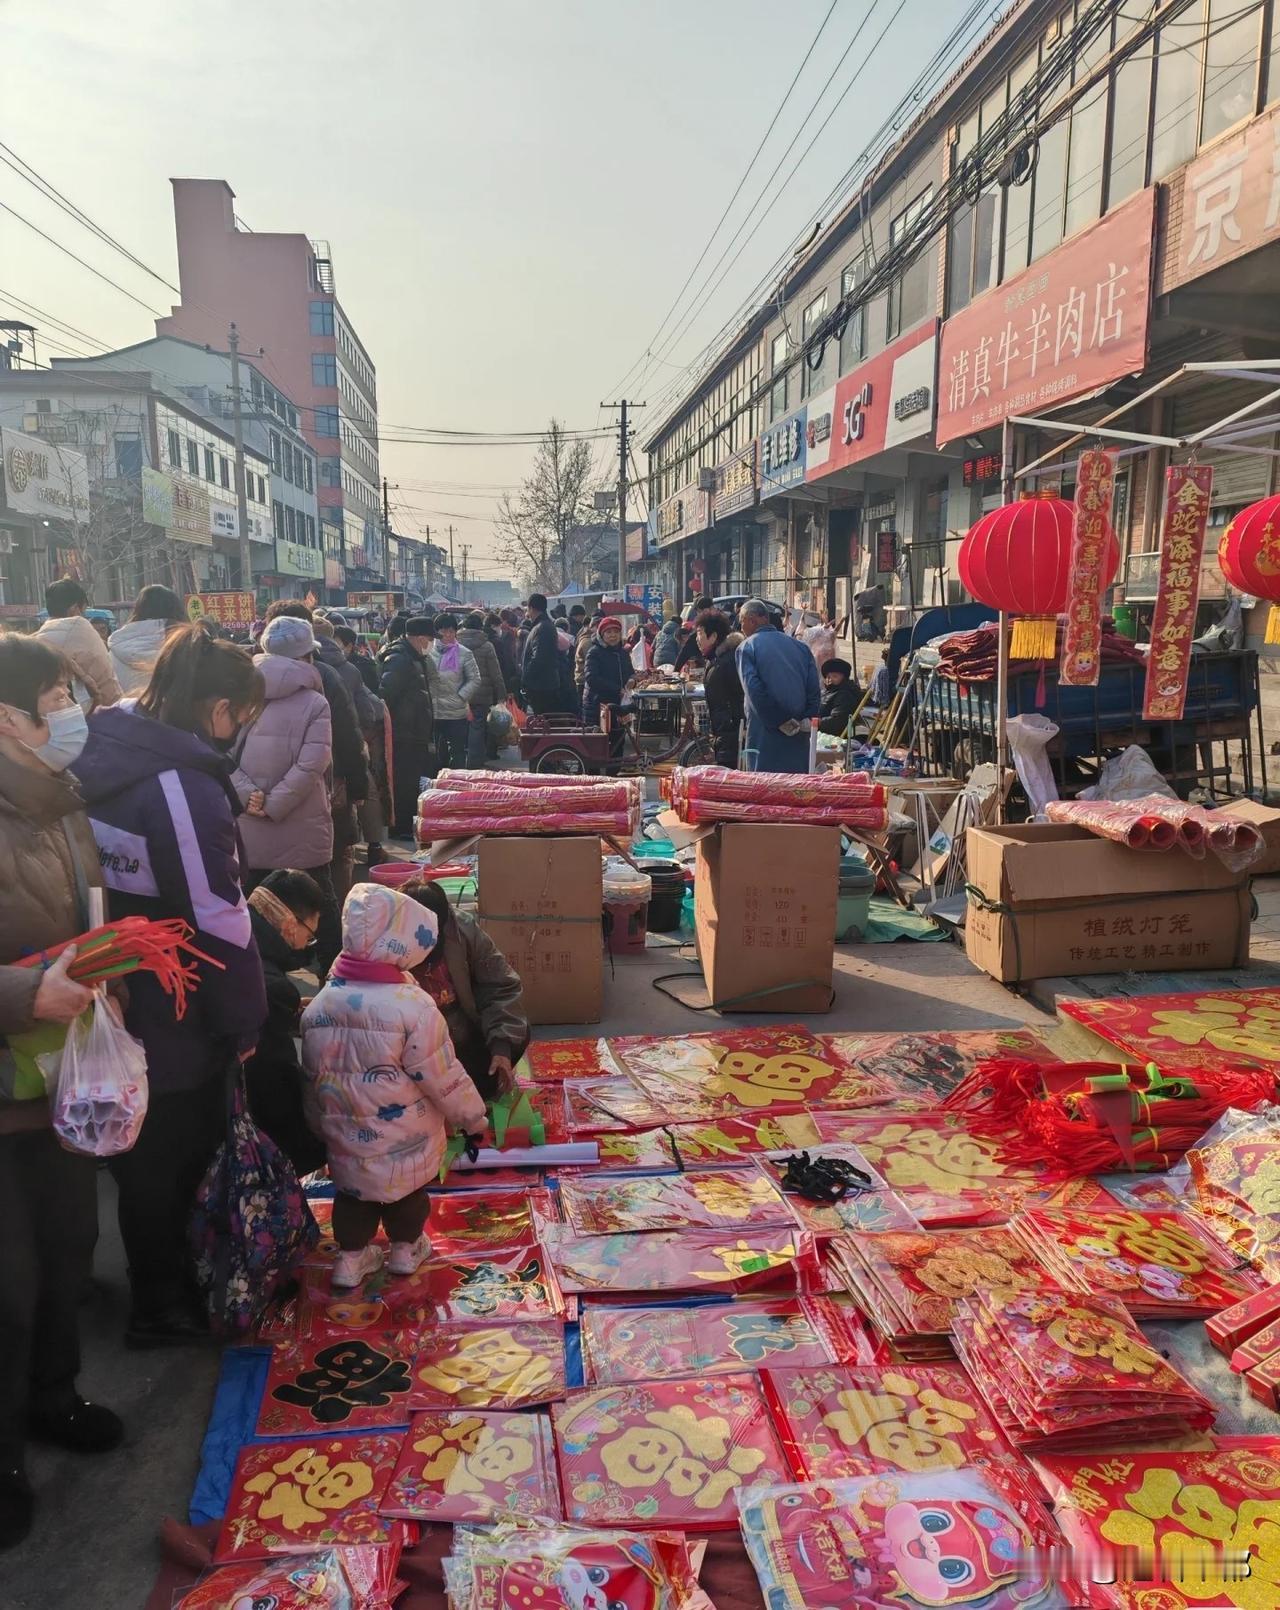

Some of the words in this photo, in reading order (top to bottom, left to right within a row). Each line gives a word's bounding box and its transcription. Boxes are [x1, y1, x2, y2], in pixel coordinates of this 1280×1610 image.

[948, 262, 1130, 413] 清真牛羊肉店
[1156, 479, 1206, 670] 金蛇添福事如意
[1083, 913, 1193, 937] 植绒灯笼
[243, 1447, 374, 1530] 福
[811, 1520, 849, 1581] 大吉大利
[481, 1568, 498, 1610] 金蛇
